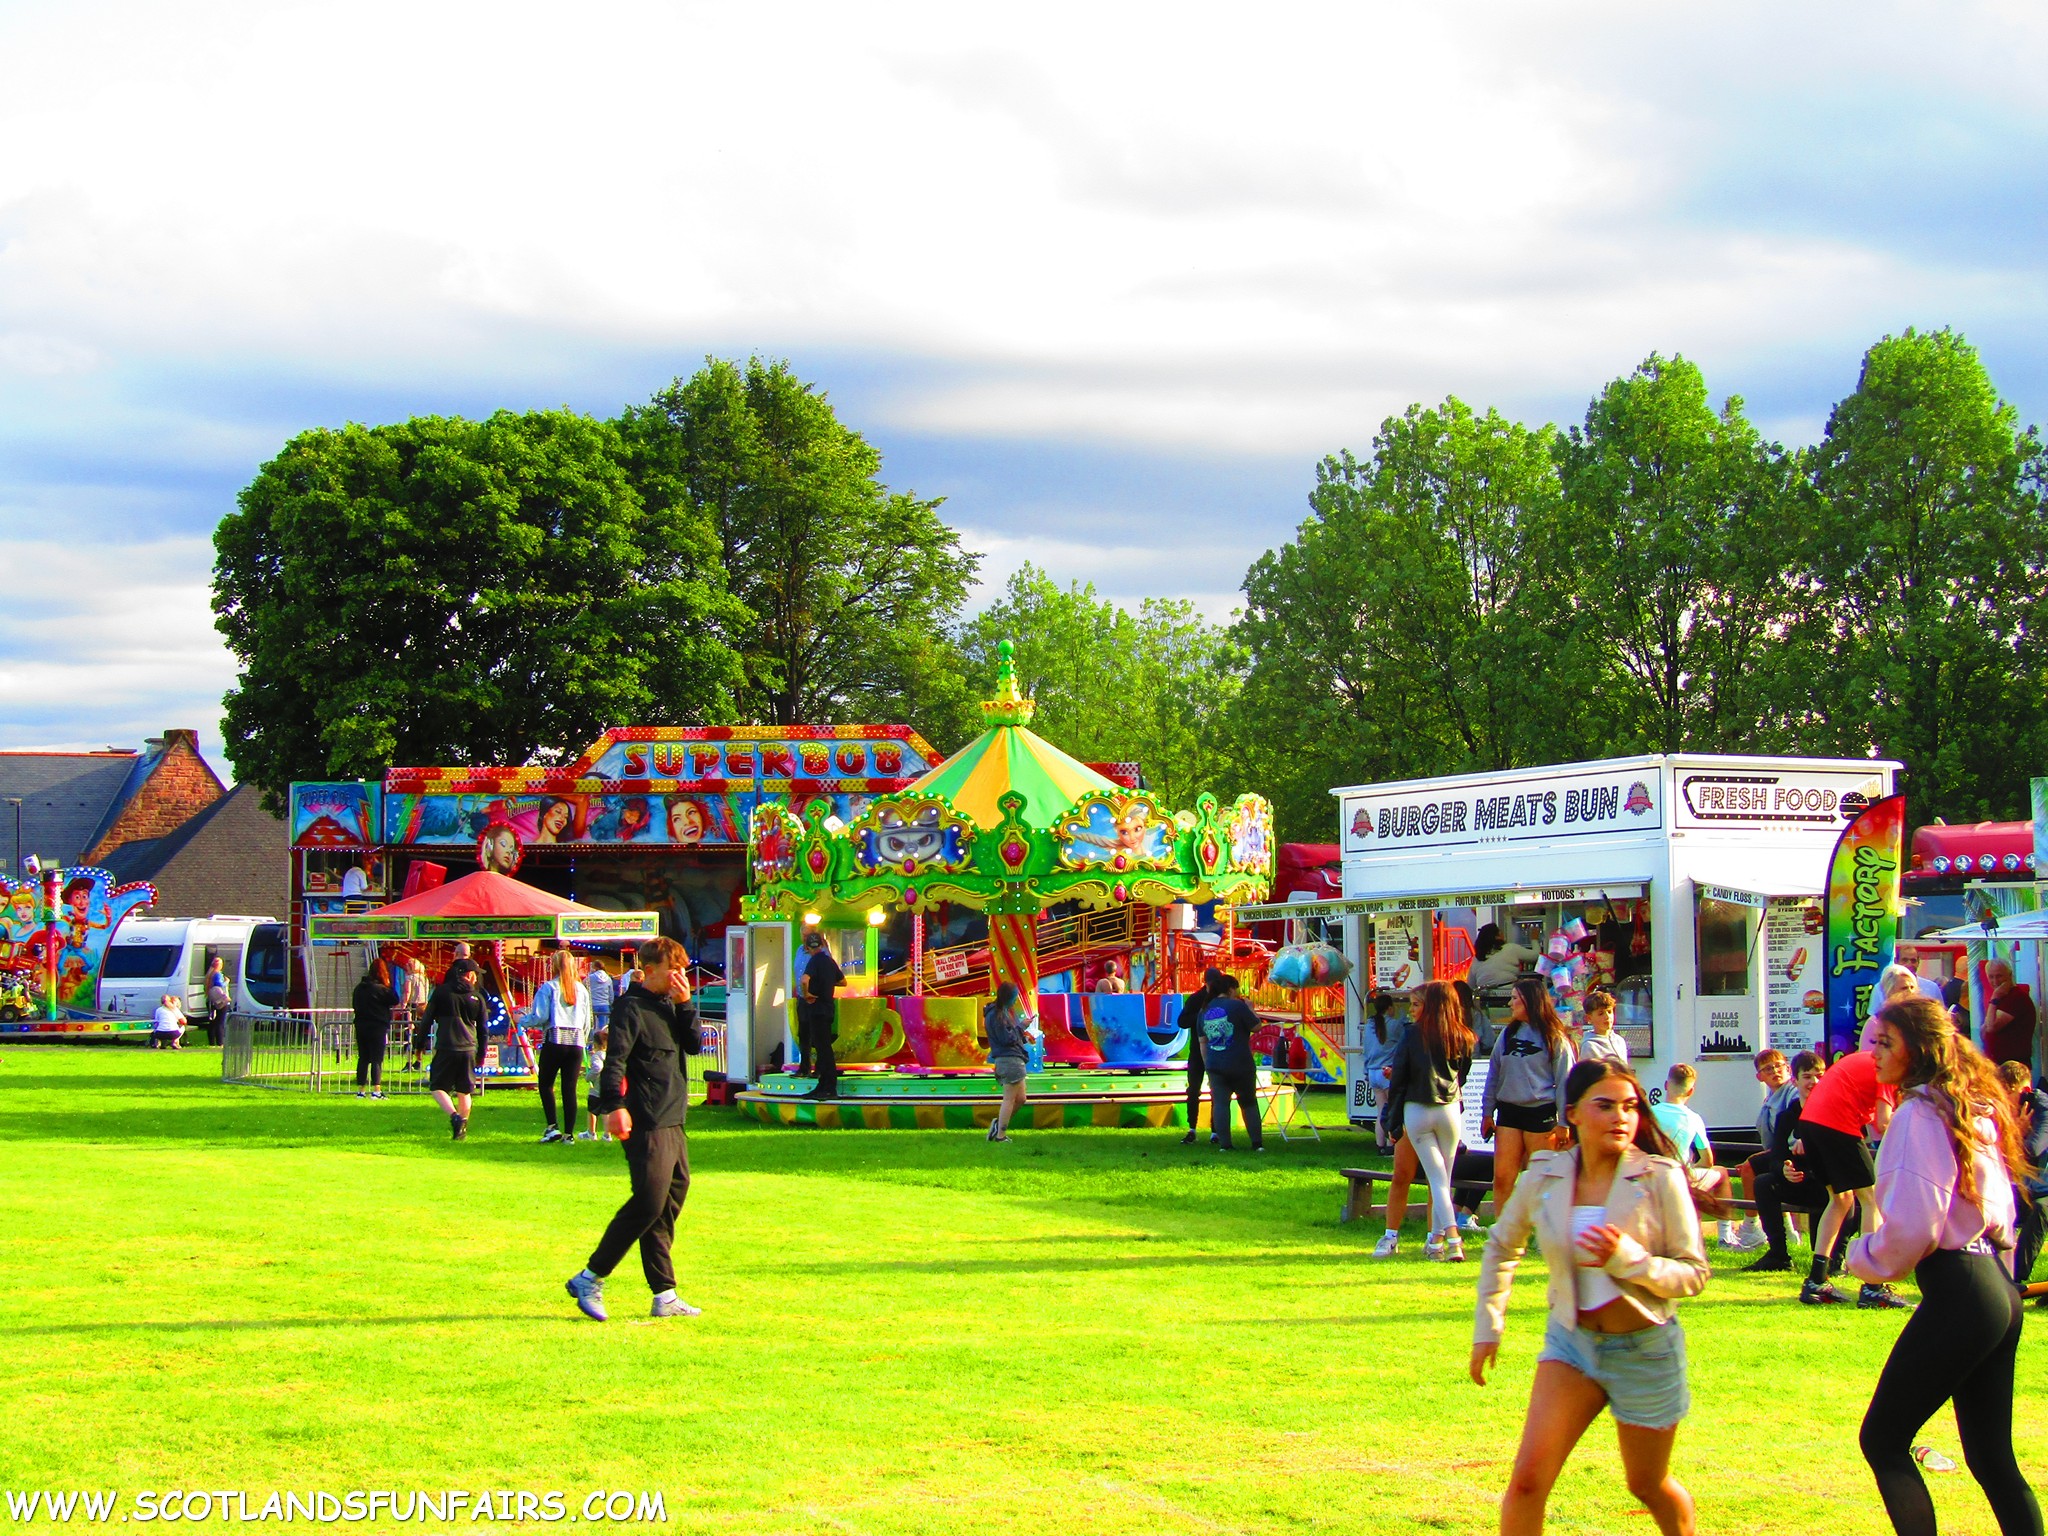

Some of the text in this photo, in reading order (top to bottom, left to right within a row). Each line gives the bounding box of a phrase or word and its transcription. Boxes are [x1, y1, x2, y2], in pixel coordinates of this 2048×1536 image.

[1699, 787, 1837, 811] FRESH FOOD
[1378, 786, 1619, 839] BURGER MEATS BUN
[1345, 904, 1365, 914] CHICKEN
[1366, 902, 1384, 912] WRAPS
[1398, 899, 1416, 910] CHEESE
[1417, 898, 1439, 908] BURGERS
[1455, 896, 1482, 907] FOOTLONG
[1482, 894, 1507, 905] SAUSAGE
[1541, 889, 1575, 901] HOTDOGS
[1713, 887, 1752, 904] CANDY FLOSS
[1710, 1020, 1739, 1028] BURGER
[1711, 1011, 1739, 1020] DALLAS
